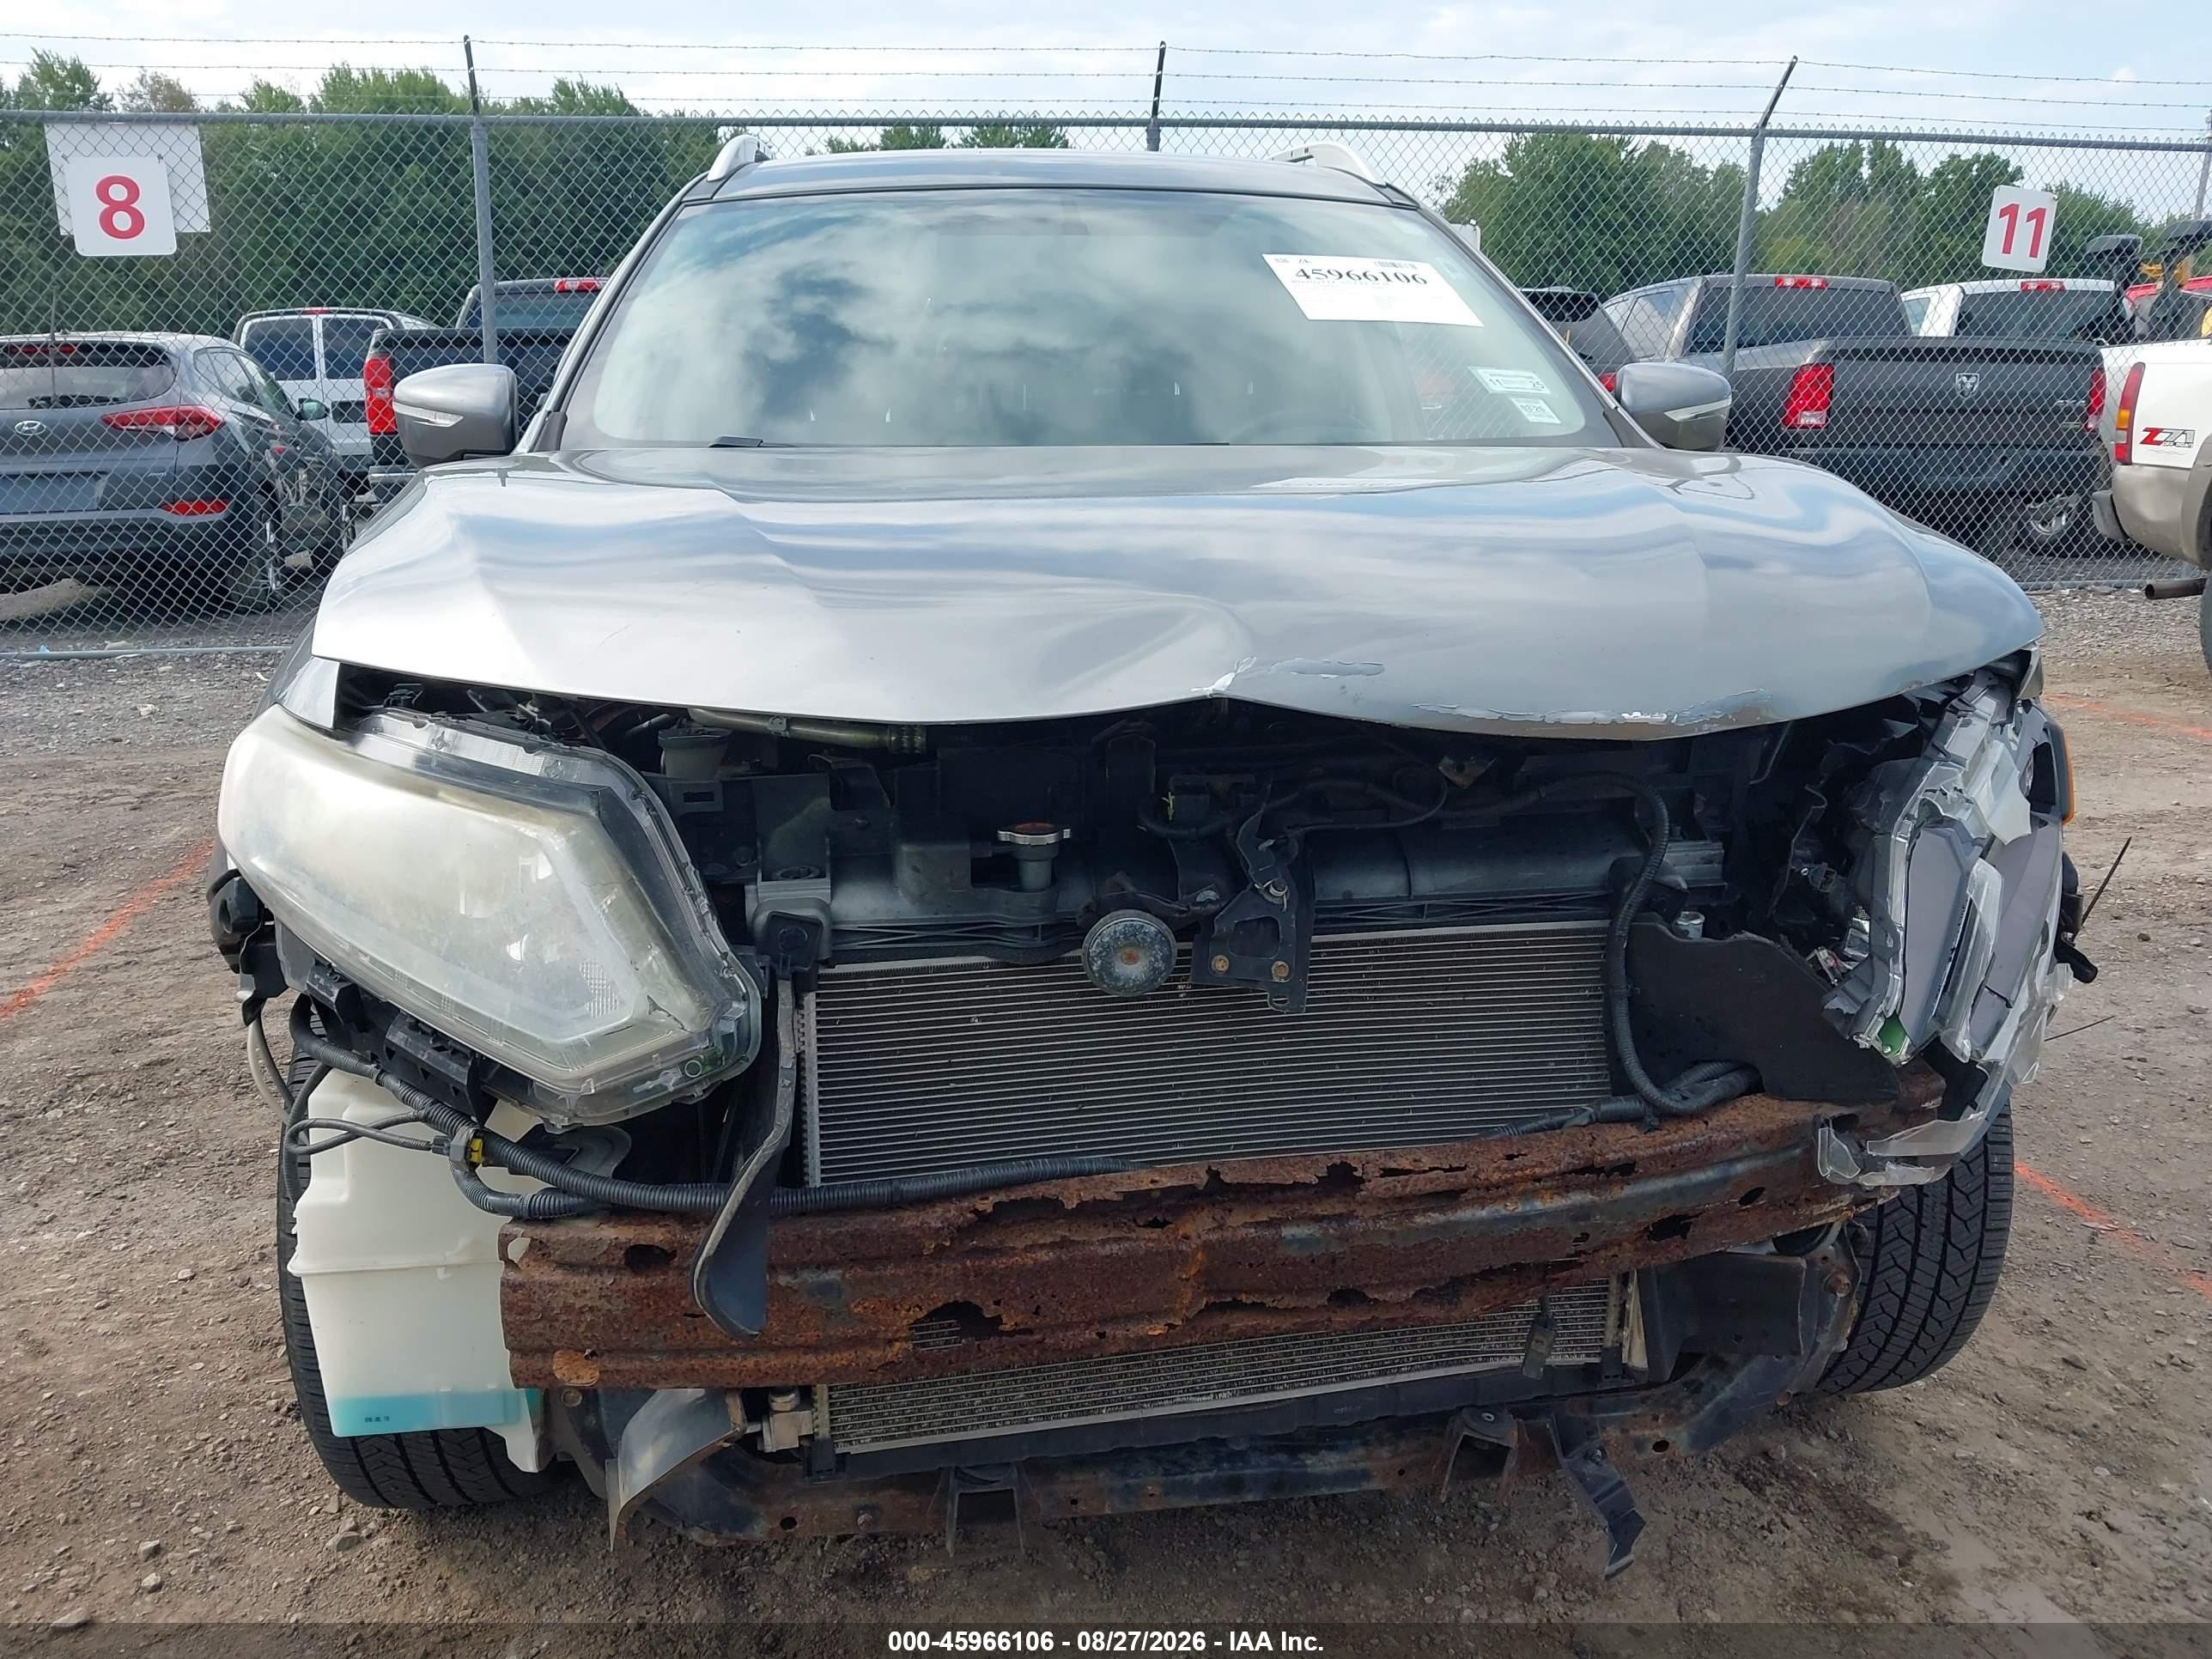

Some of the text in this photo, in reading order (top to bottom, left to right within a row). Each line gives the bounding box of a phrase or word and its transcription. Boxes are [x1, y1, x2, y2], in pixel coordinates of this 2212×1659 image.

[94, 174, 145, 240] 8
[1998, 203, 2047, 258] 11
[1295, 268, 1428, 286] 45966106
[2139, 427, 2196, 447] Z71
